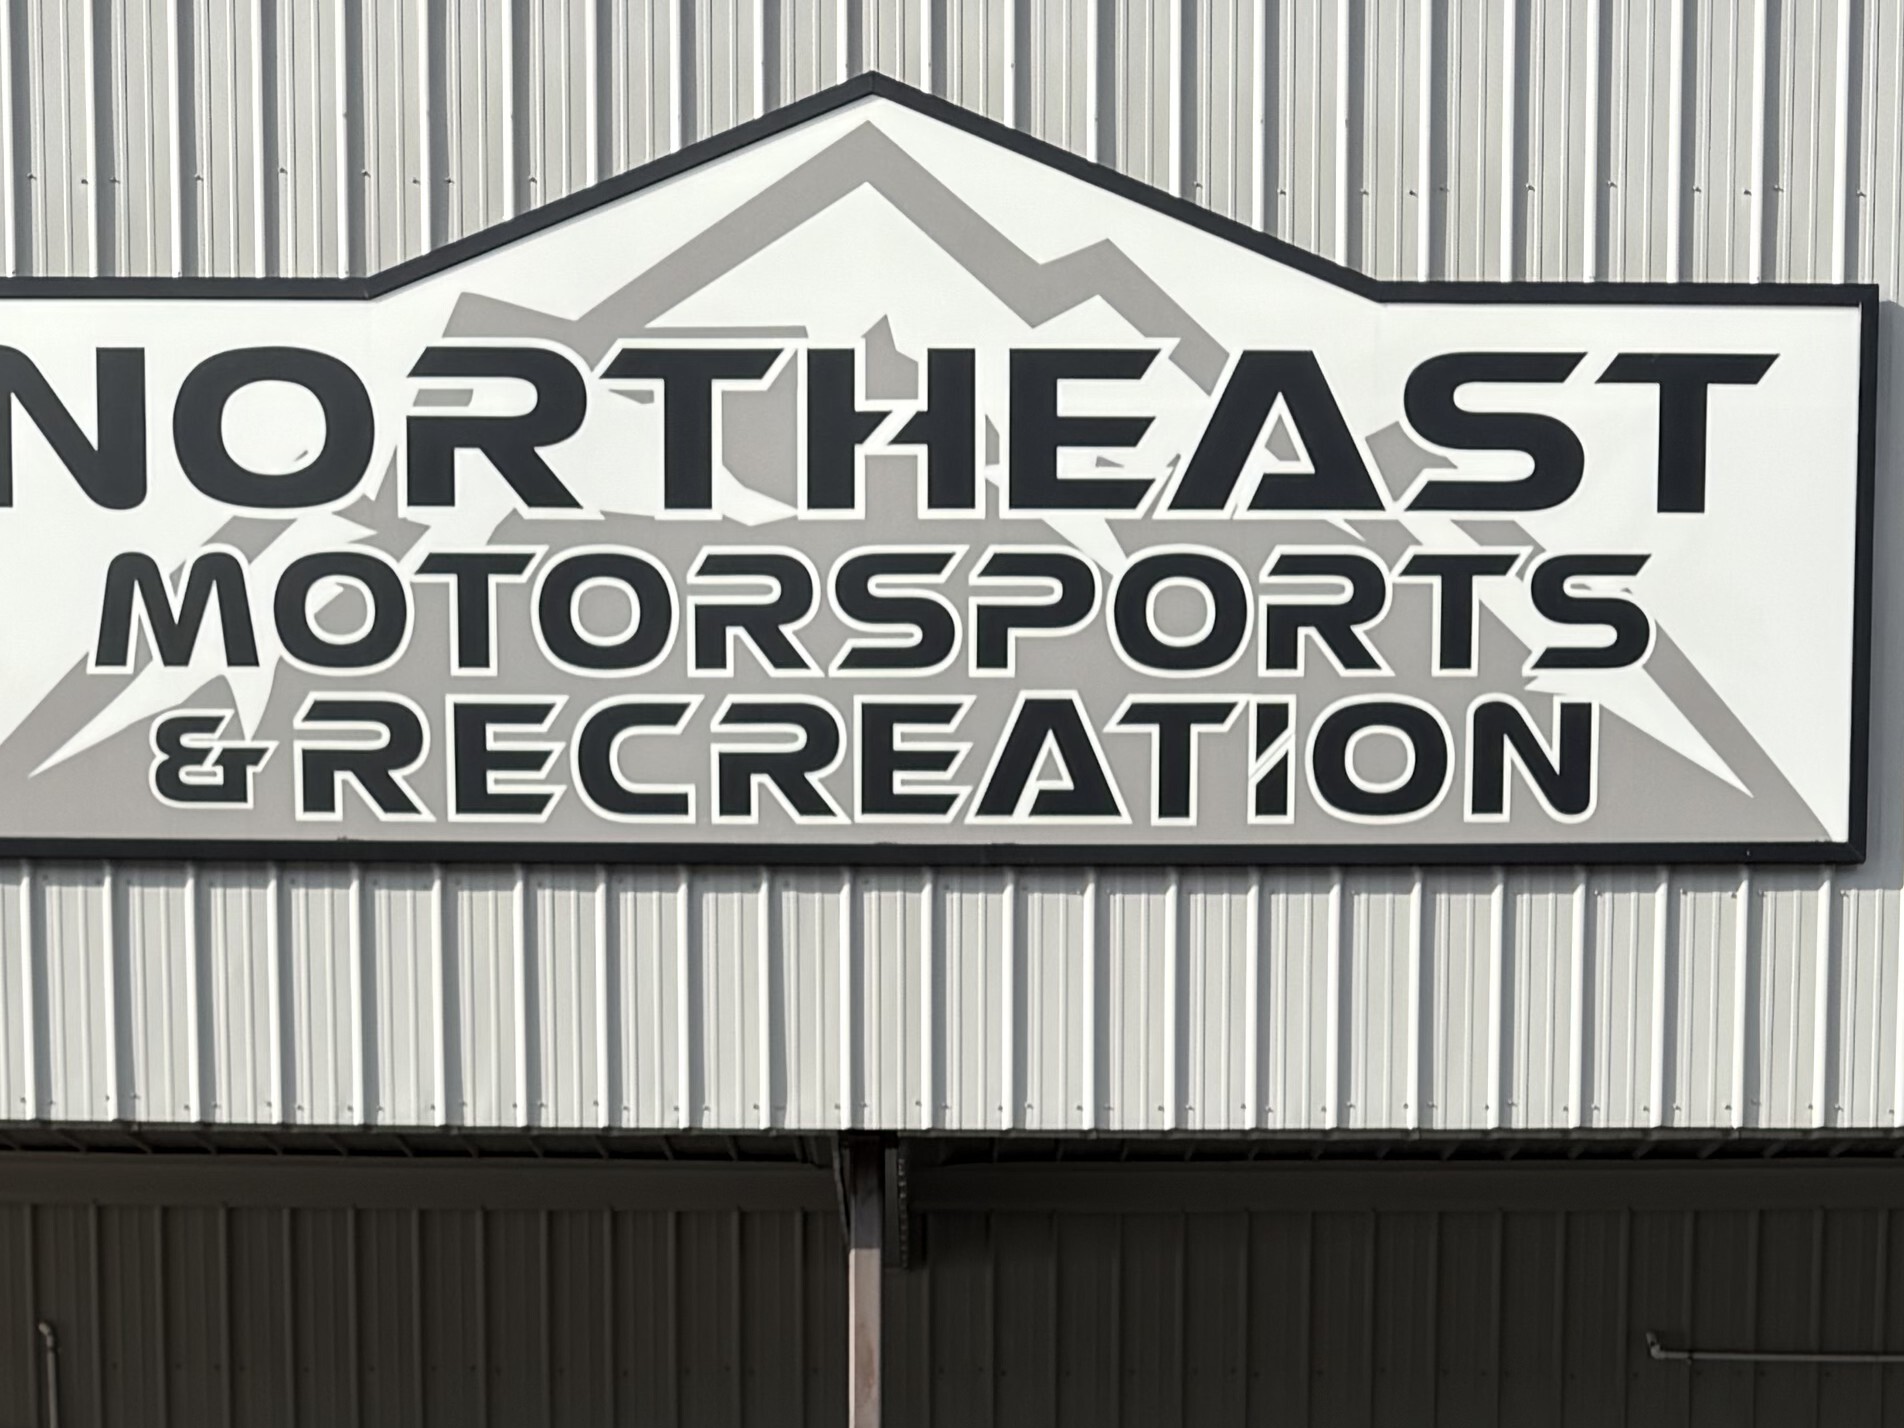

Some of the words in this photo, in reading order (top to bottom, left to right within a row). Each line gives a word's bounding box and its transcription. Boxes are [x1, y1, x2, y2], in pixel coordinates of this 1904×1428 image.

[96, 553, 1649, 669] MOTORSPORTS
[156, 717, 265, 801] &
[303, 700, 1591, 817] RECREATION
